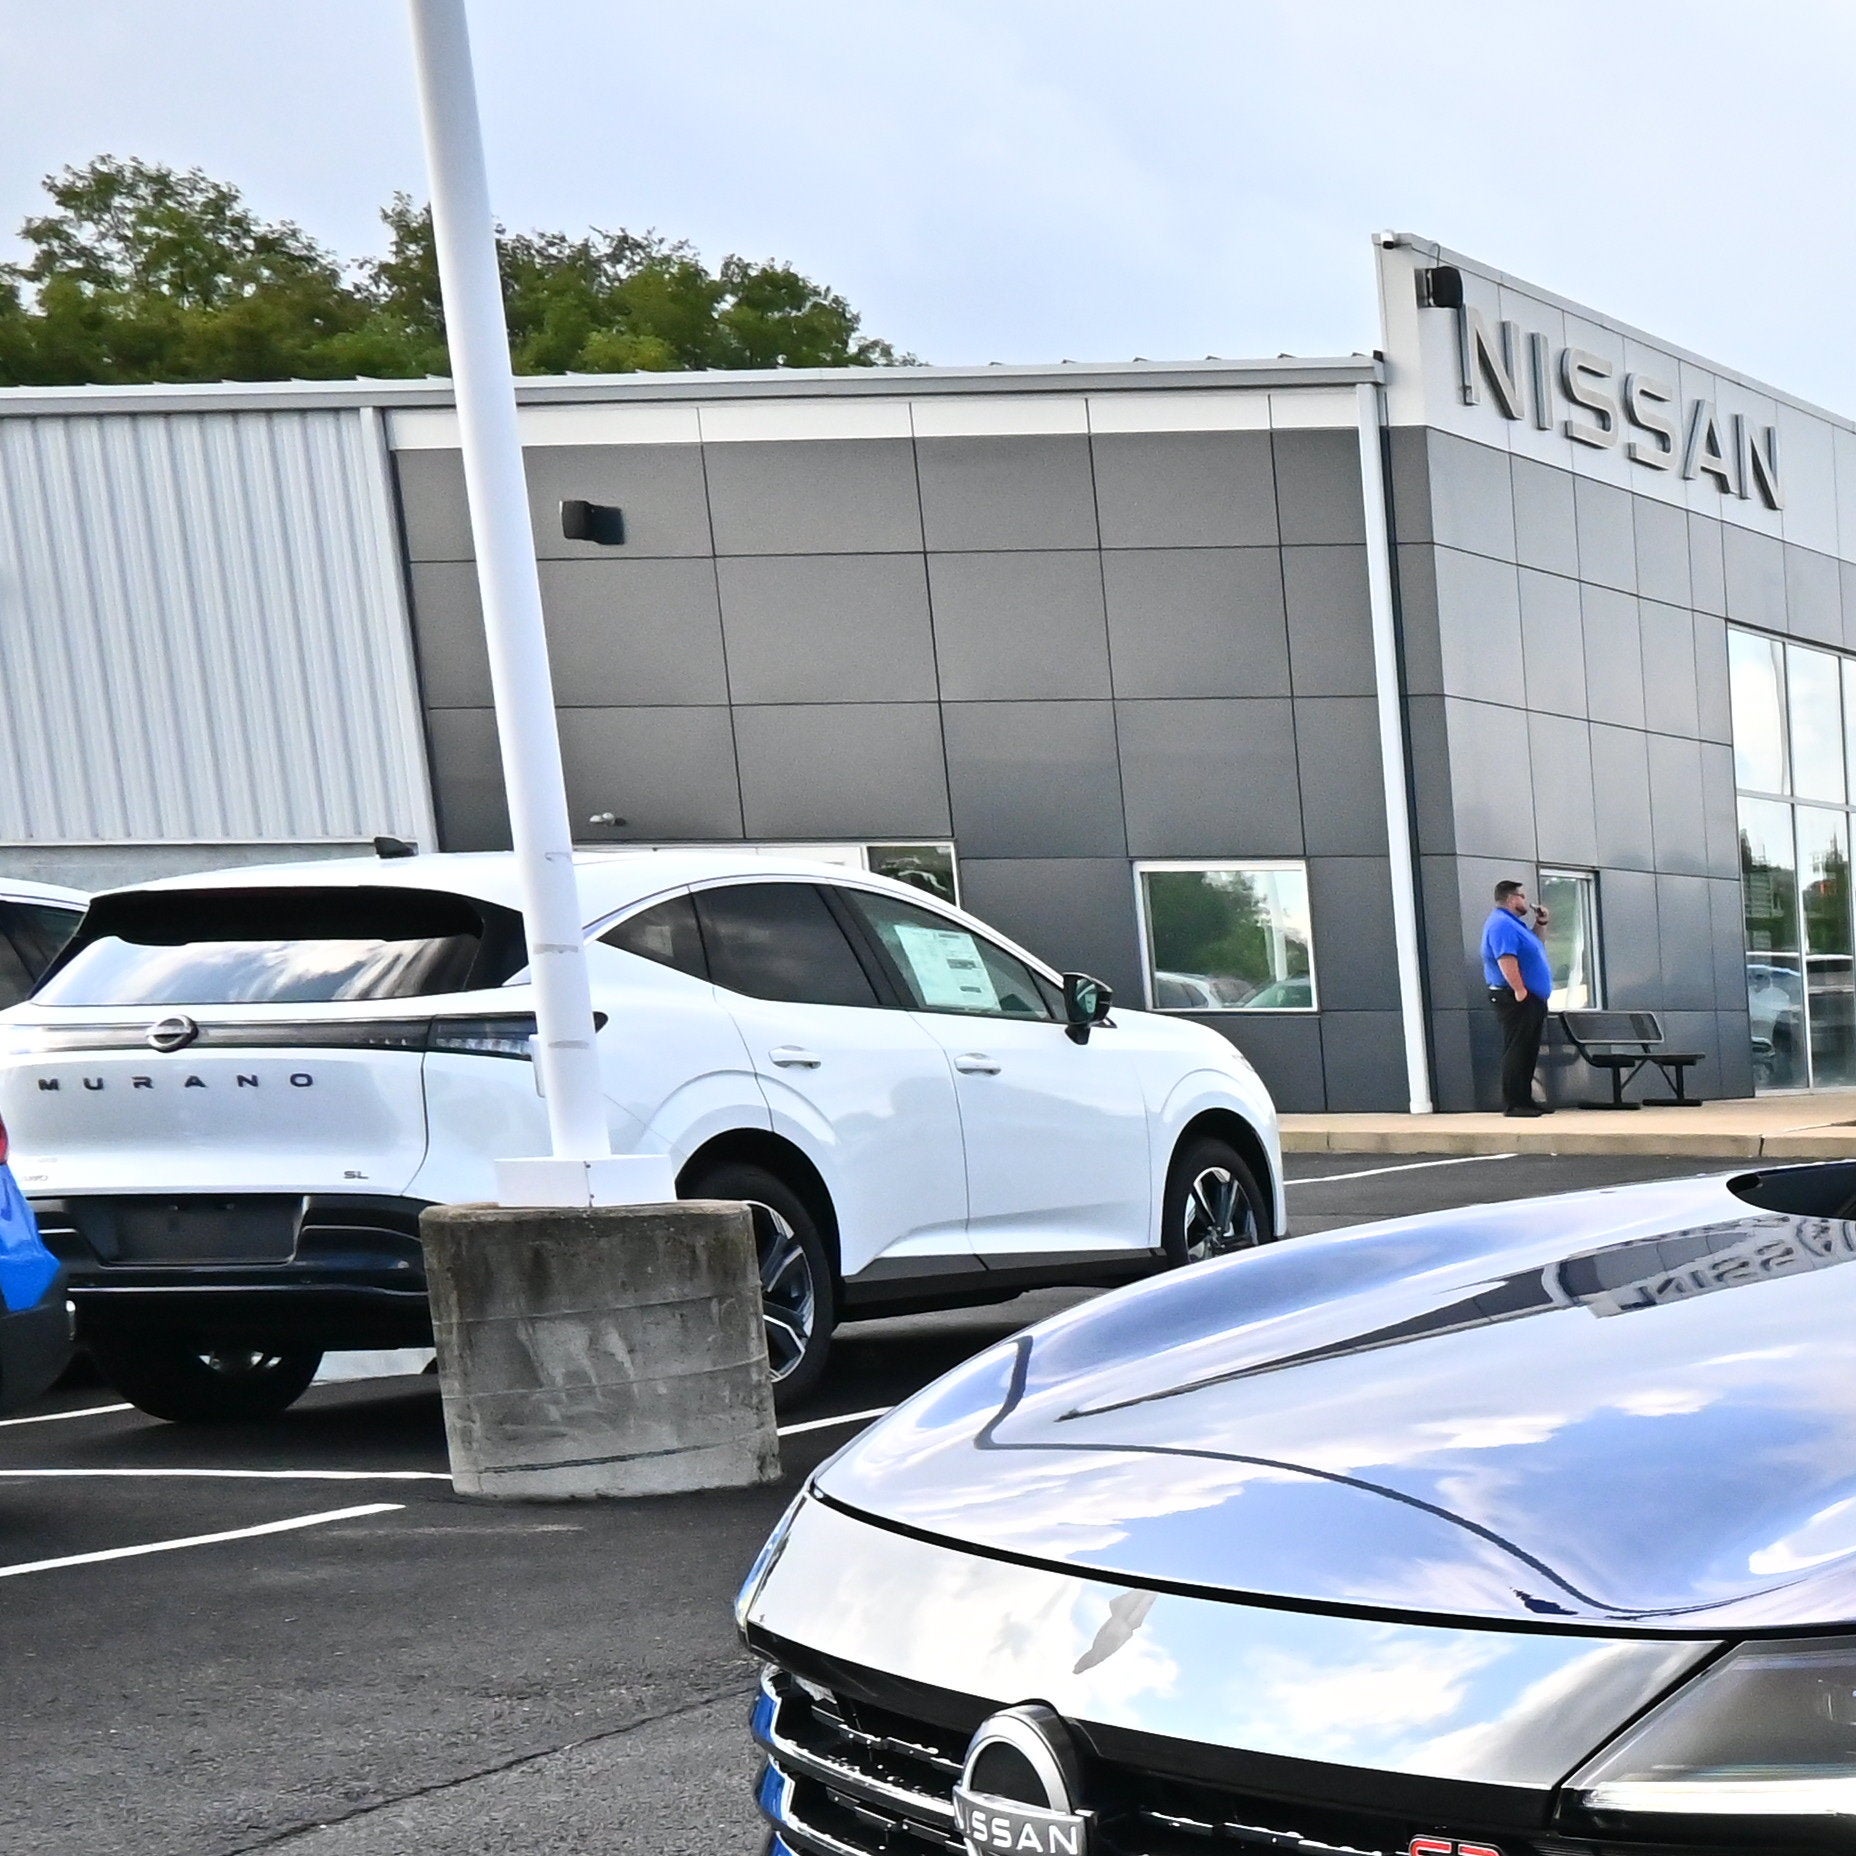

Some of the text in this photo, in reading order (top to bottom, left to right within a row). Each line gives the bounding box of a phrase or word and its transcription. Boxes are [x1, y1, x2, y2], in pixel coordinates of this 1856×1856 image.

[1457, 302, 1785, 512] NISSAN
[38, 1072, 313, 1092] MURANO
[344, 1170, 369, 1180] SL
